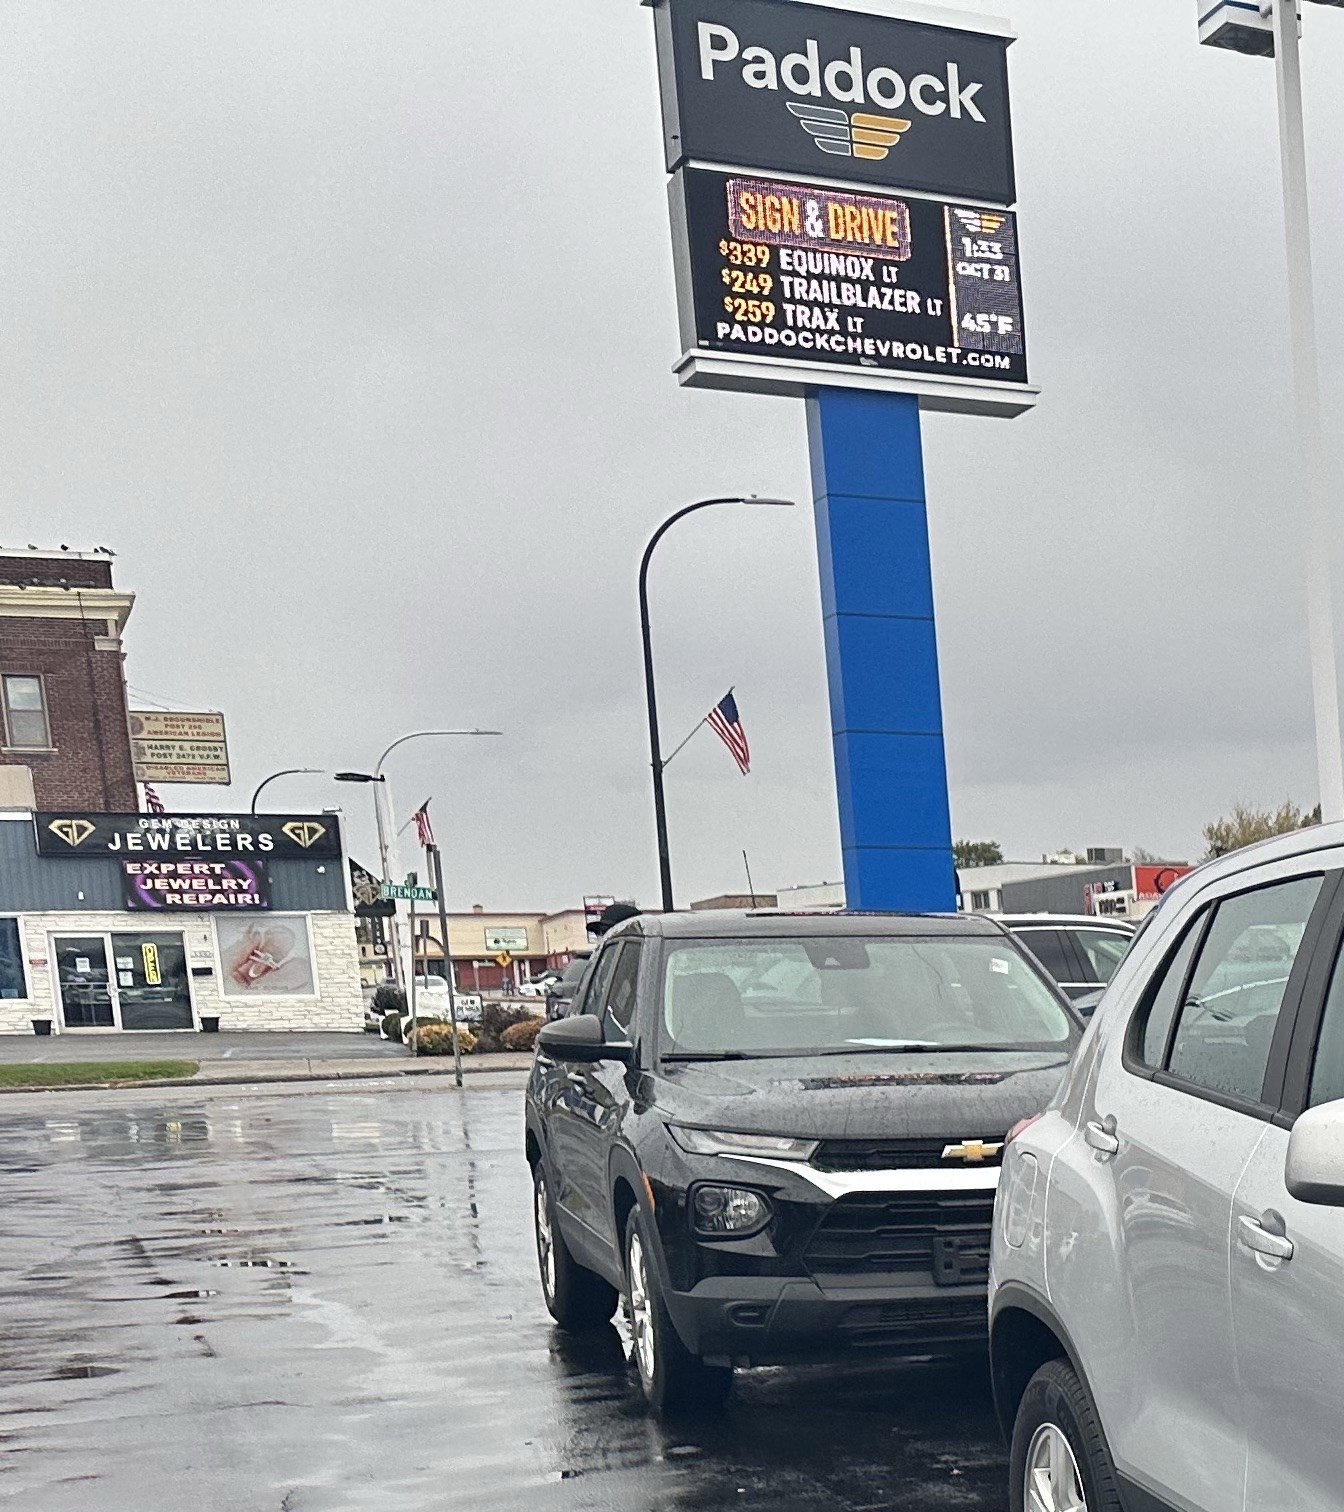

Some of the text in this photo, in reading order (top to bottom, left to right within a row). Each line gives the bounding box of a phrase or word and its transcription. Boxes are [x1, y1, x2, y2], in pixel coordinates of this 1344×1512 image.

[697, 21, 986, 123] Paddock
[740, 191, 899, 248] SIGN & DRIVE
[962, 237, 1003, 259] 1:33
[718, 239, 898, 283] $339 EQUINOX LT
[956, 261, 992, 280] OCT
[721, 268, 943, 316] $249 TRAILBLAZER LT
[723, 296, 864, 333] $259 TRAX LT
[716, 321, 1011, 370] PADDOCKCHEVROLET.COM
[139, 819, 240, 830] GEM DESIGN
[107, 833, 274, 851] JEWELERS
[126, 863, 226, 875] EXPERT
[139, 879, 252, 890] JEWELRY
[383, 886, 433, 899] BRENDAN
[165, 893, 260, 905] REPAIR!
